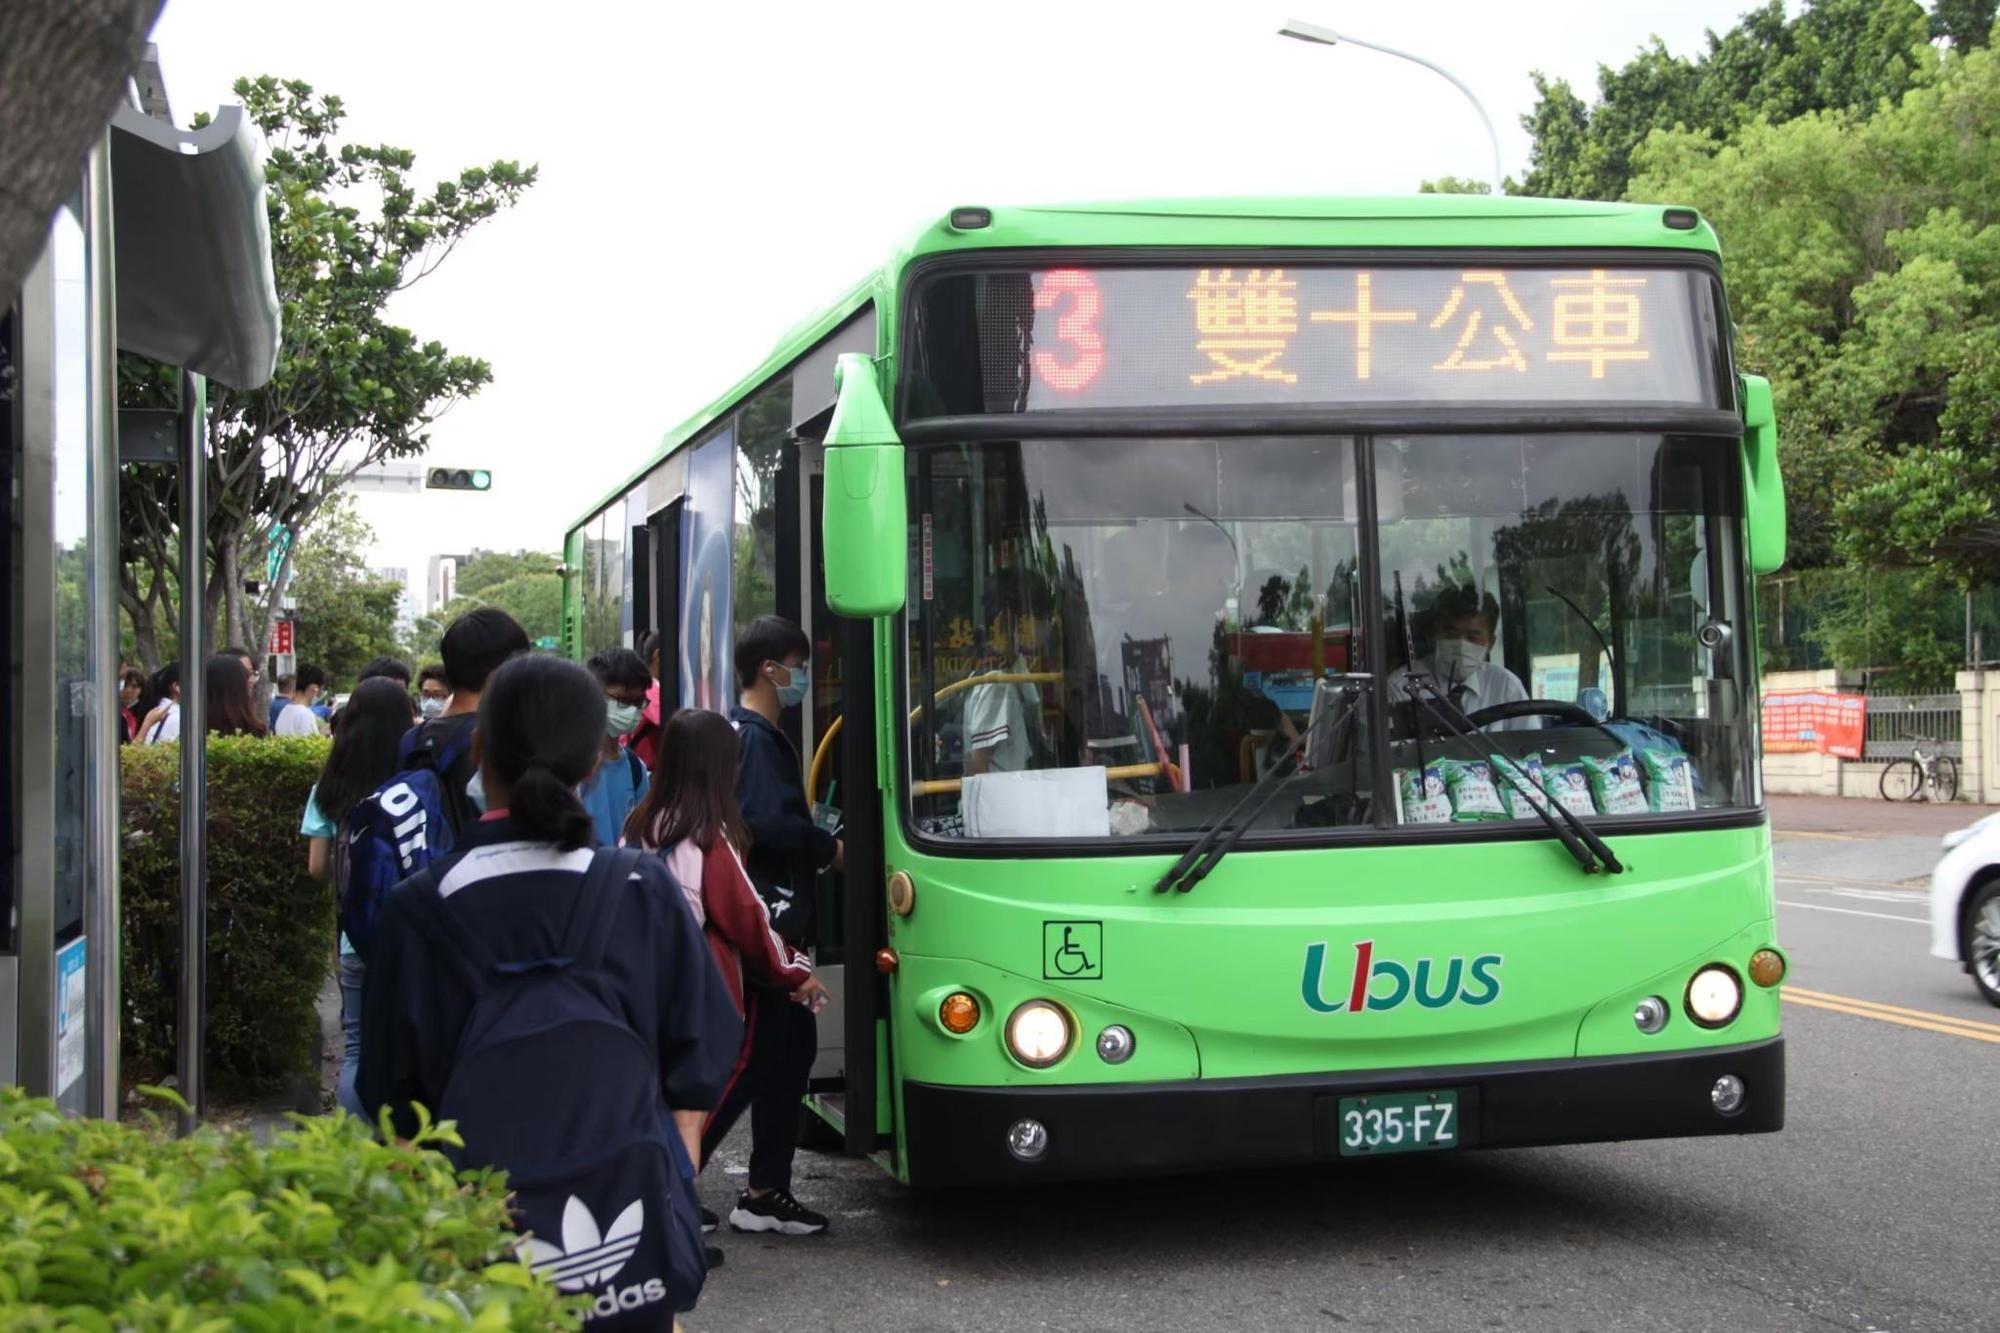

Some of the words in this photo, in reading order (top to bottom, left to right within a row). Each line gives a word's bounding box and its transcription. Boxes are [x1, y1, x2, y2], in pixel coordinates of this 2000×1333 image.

[1034, 267, 1104, 391] 3
[1189, 267, 1650, 383] 雙十公車
[1300, 939, 1504, 1014] Ubus
[1343, 1103, 1454, 1148] 335-FZ
